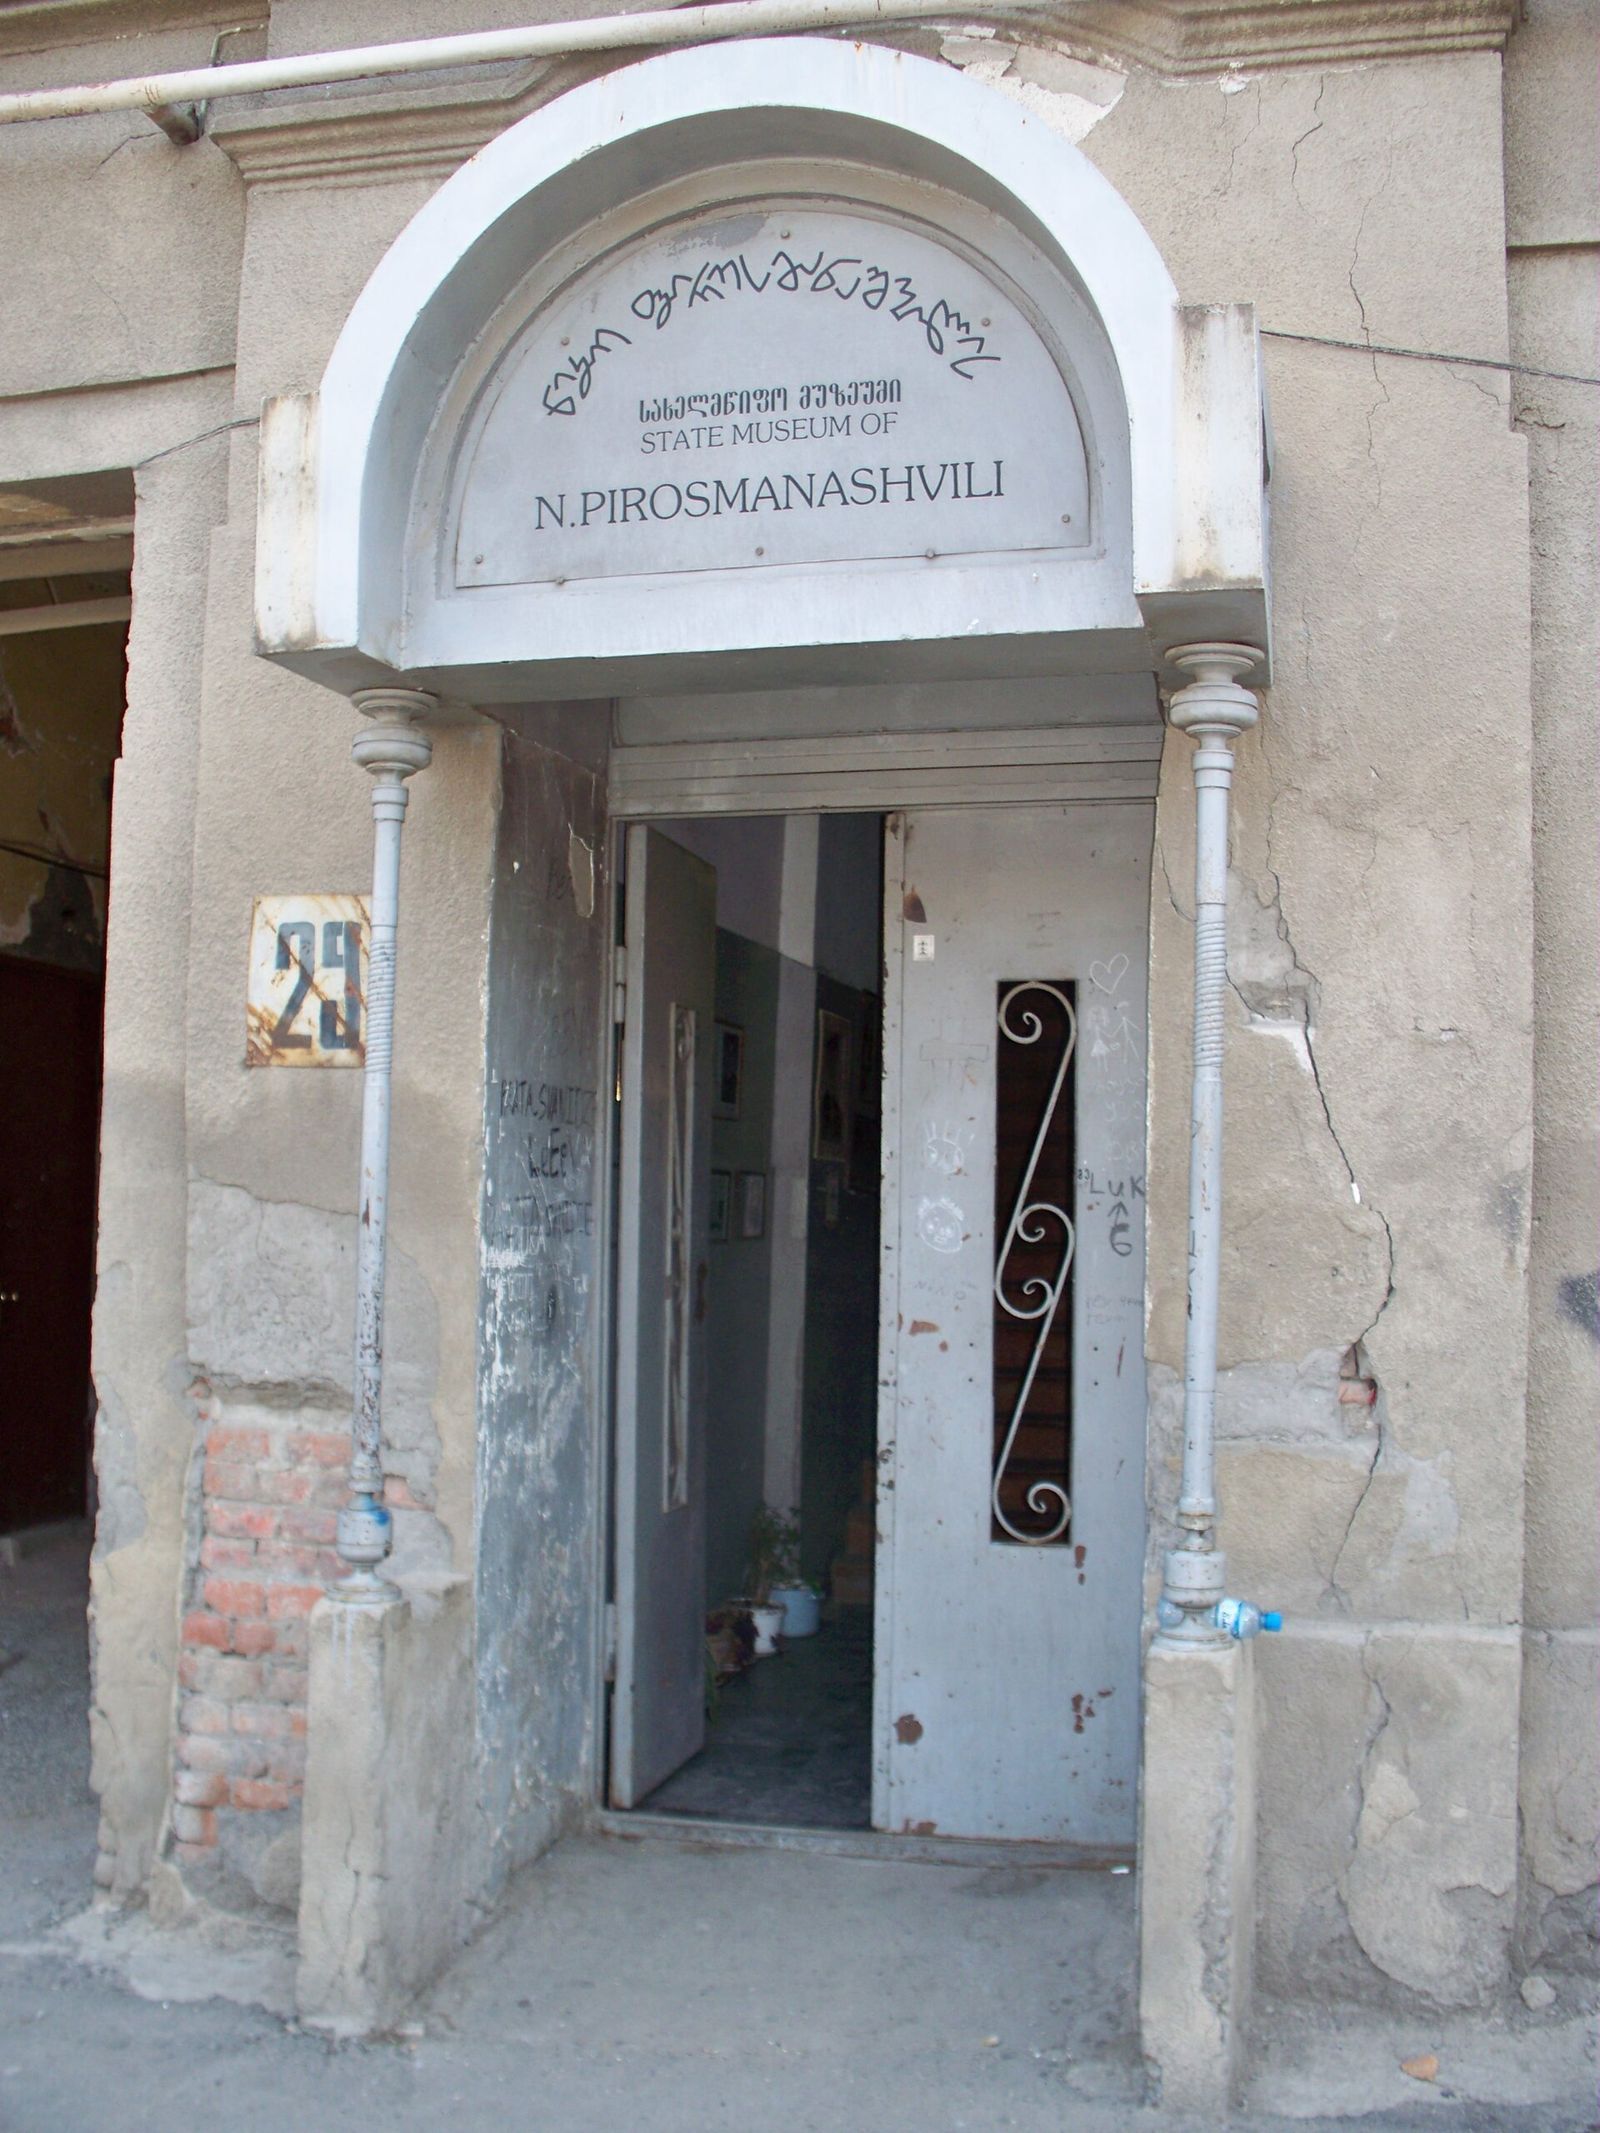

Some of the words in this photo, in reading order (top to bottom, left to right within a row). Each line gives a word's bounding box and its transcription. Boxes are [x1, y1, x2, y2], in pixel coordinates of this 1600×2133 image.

[639, 387, 788, 423] სახელმწიფო
[799, 378, 902, 410] მუზეუმი
[640, 425, 724, 455] STATE
[732, 414, 852, 445] MUSEUM
[860, 411, 899, 436] OF
[534, 459, 1006, 531] N.PIROSMANASHVILI
[270, 920, 361, 1050] 29
